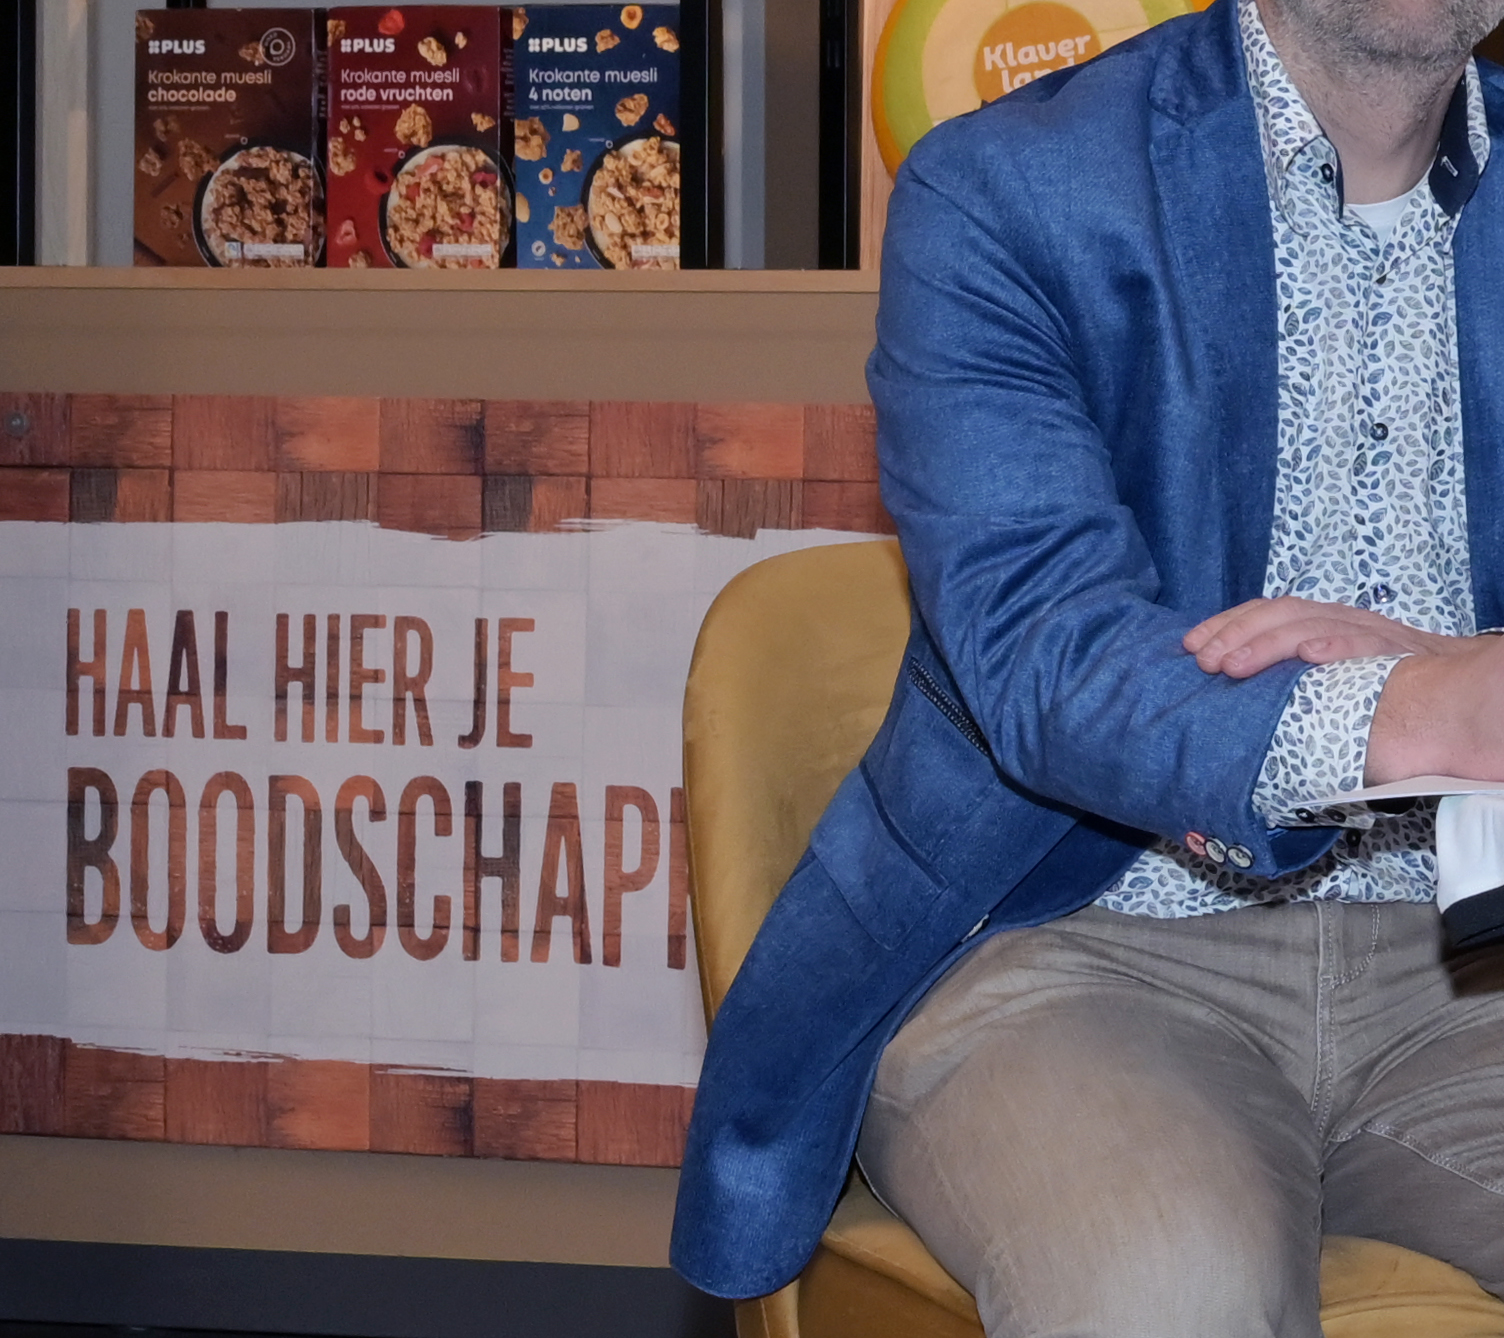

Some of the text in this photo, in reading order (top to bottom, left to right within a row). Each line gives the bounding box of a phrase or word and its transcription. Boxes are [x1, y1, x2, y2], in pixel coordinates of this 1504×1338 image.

[162, 40, 205, 54] PLUS
[353, 39, 395, 53] PLUS
[542, 38, 587, 52] PLUS
[983, 34, 1091, 71] Klaver
[148, 70, 272, 84] Krokante muesli
[341, 69, 459, 83] Krokante muesli
[529, 69, 658, 83] Krokante muesli
[148, 87, 236, 102] chocolade
[341, 86, 453, 102] rode vruchten
[529, 88, 592, 101] 4 noten
[66, 608, 535, 749] HAAL HIER JE
